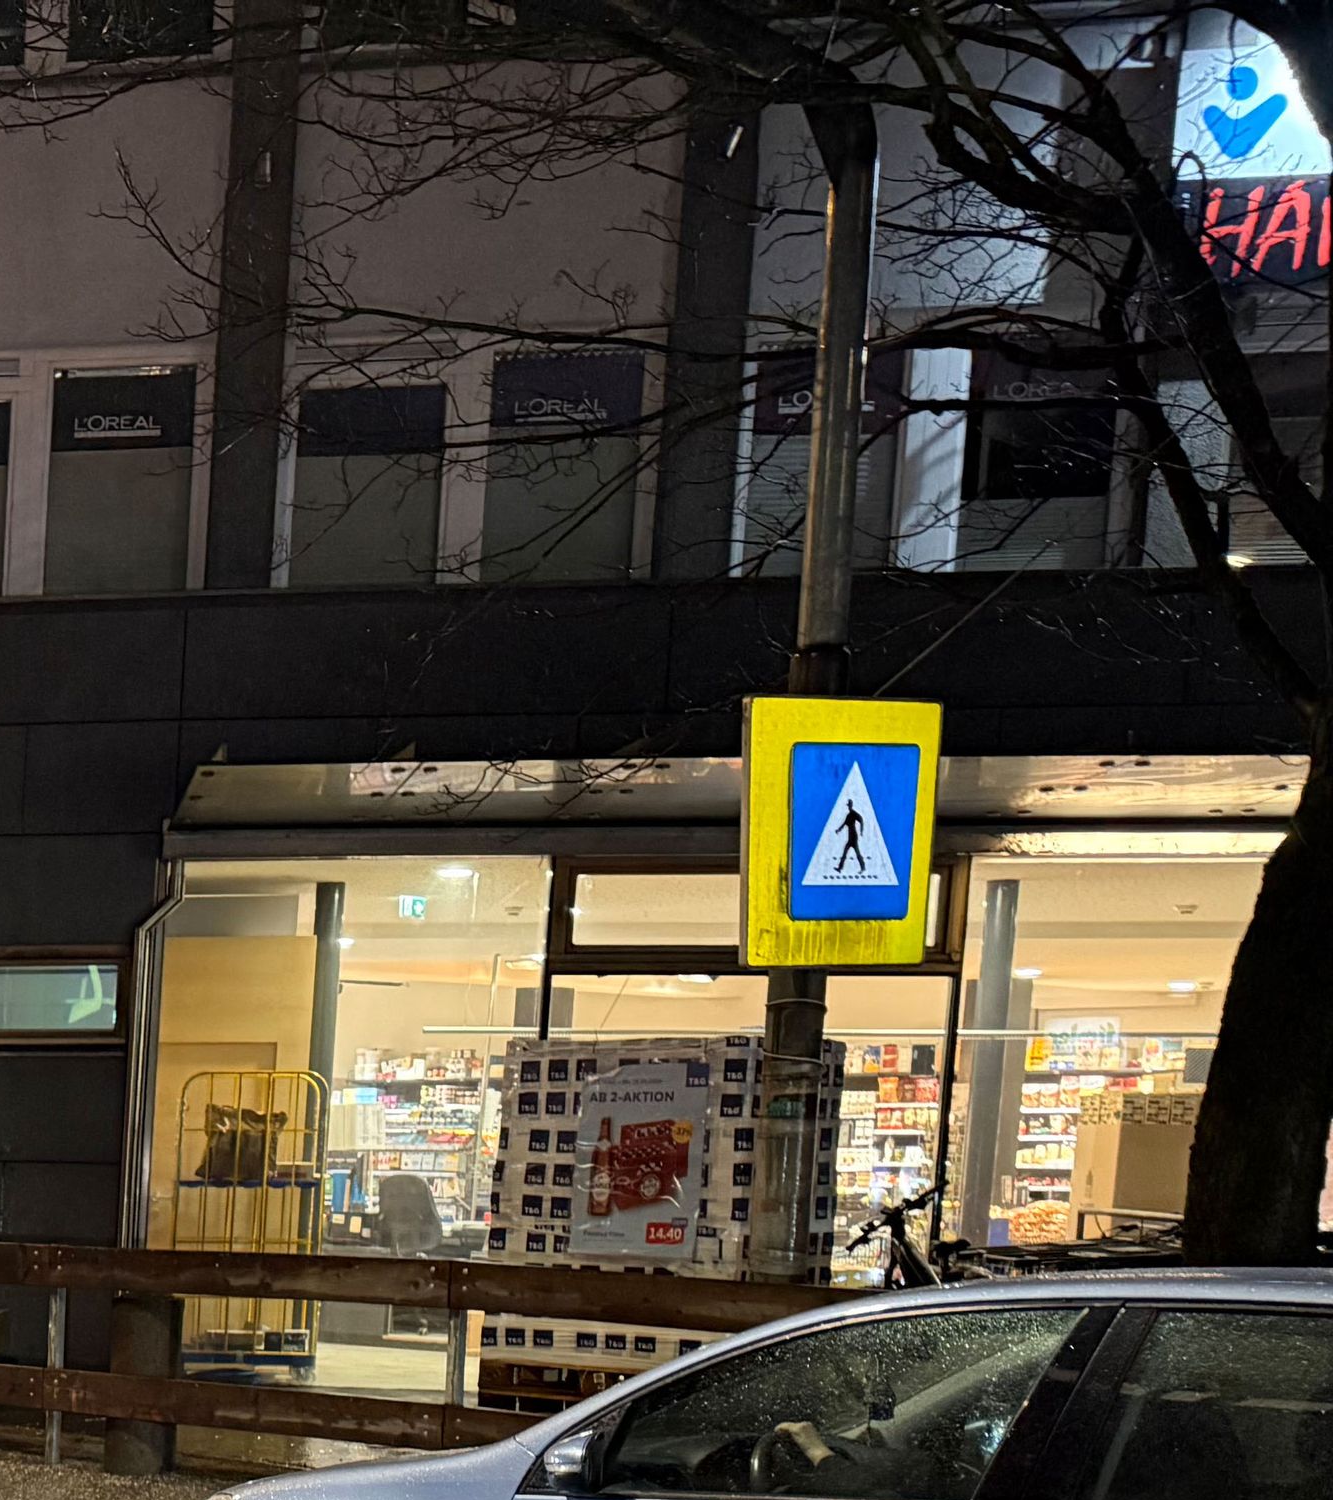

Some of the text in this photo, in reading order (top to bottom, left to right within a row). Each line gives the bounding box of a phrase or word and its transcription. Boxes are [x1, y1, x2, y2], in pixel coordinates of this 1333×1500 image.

[590, 1091, 675, 1103] AB 2-AKTION
[648, 1227, 683, 1240] 14.40
